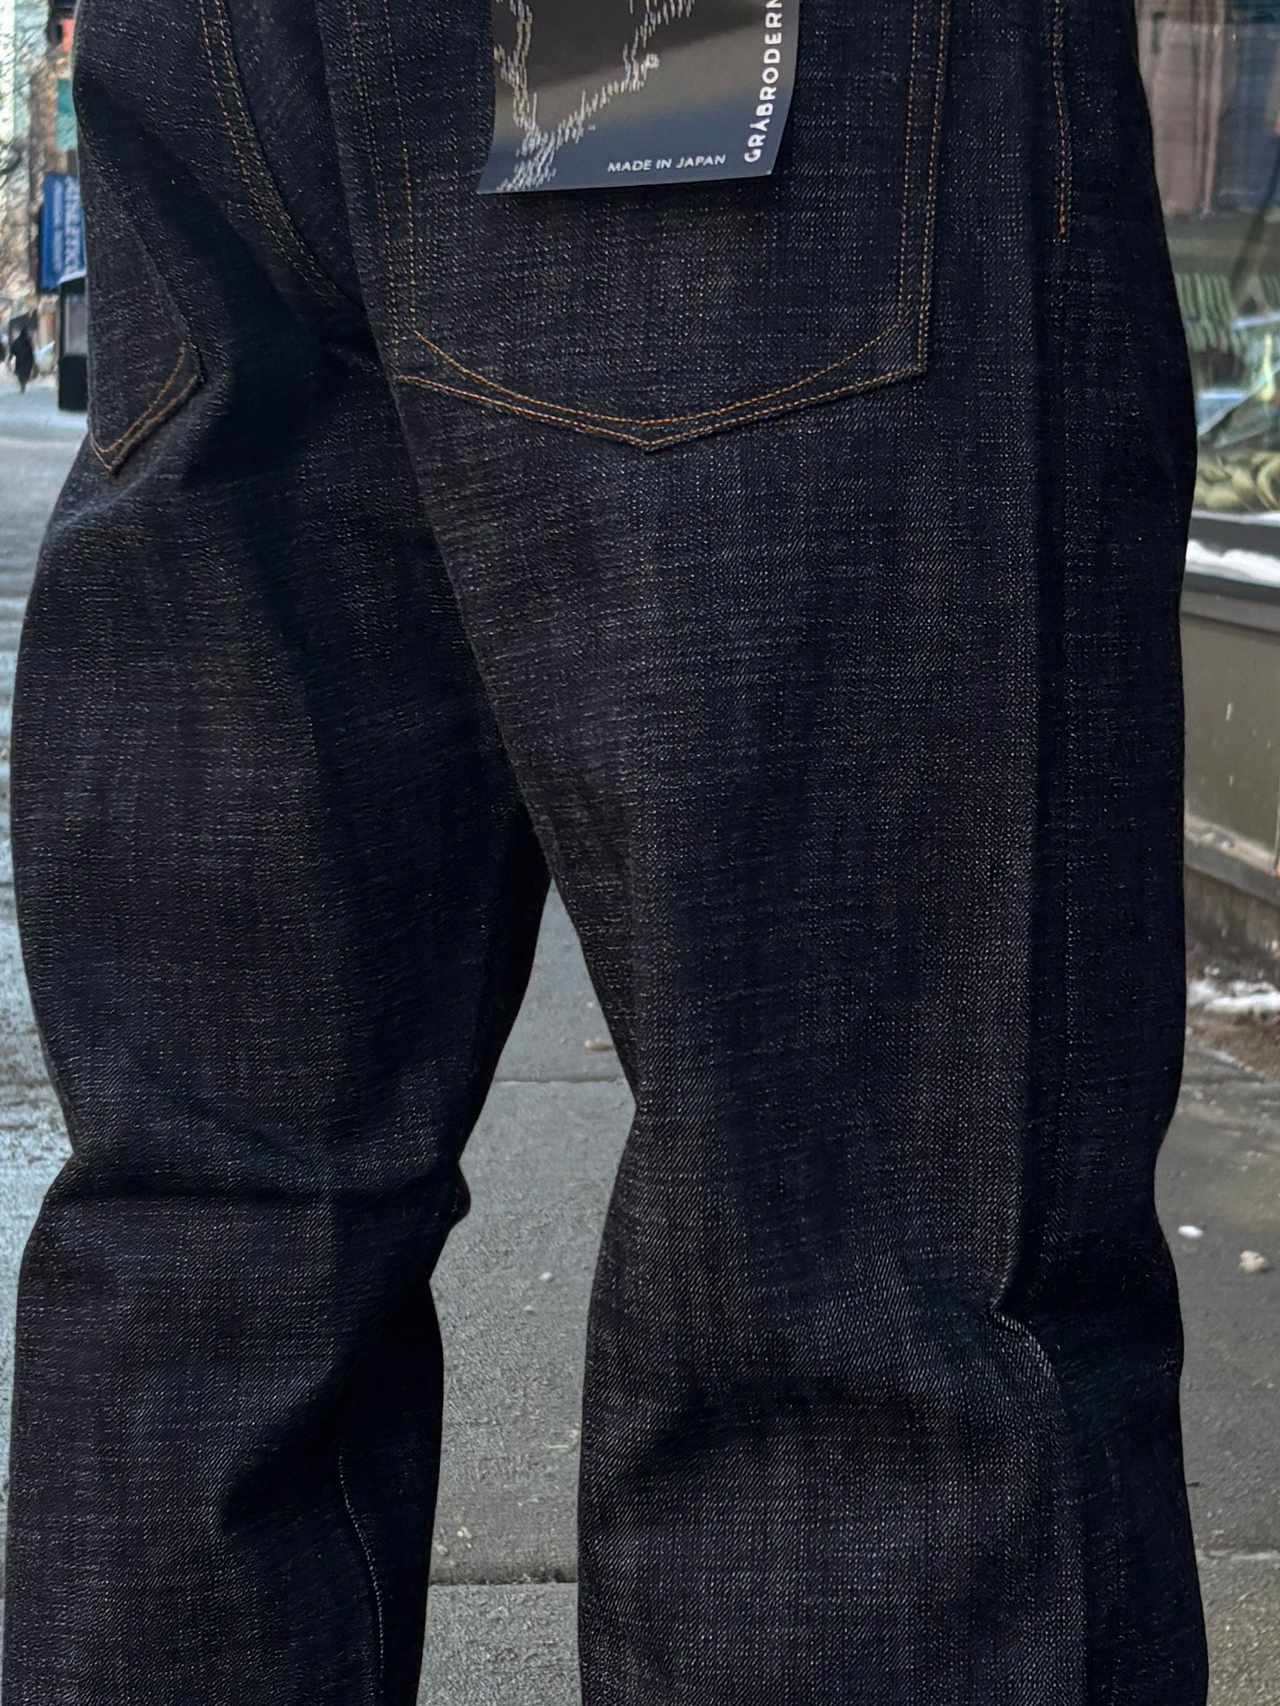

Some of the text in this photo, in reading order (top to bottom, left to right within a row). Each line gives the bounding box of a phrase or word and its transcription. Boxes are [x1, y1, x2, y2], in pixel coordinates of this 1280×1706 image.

[607, 154, 727, 173] MADE IN JAPAN
